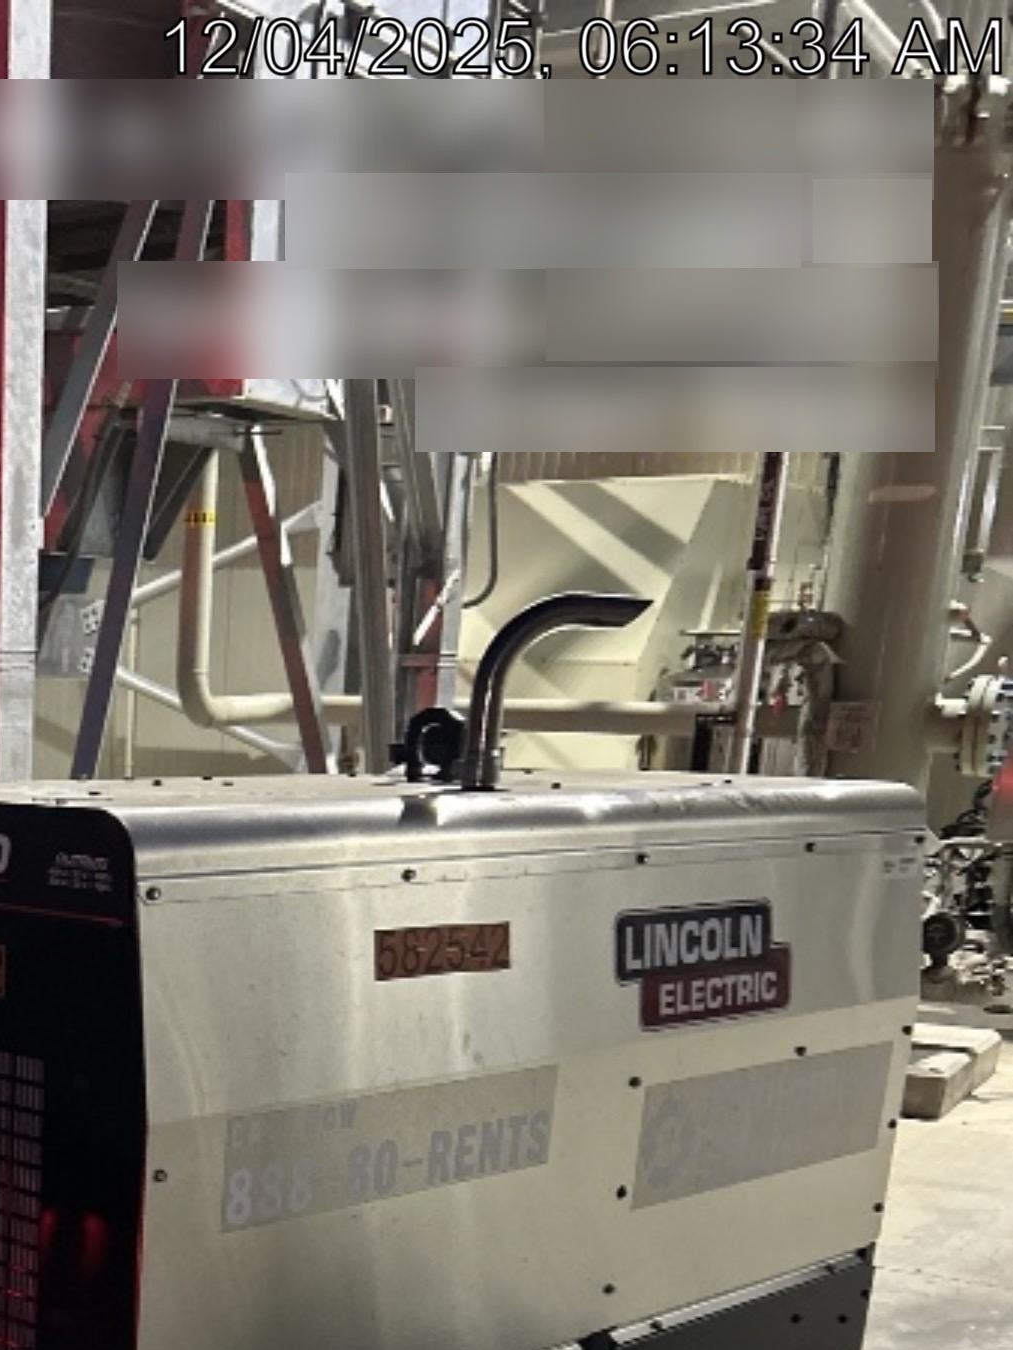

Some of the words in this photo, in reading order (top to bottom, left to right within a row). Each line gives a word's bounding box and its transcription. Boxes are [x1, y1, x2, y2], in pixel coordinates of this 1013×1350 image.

[376, 921, 510, 979] 582542
[625, 914, 763, 970] LINCOLN
[659, 971, 778, 1016] ELECTRIC
